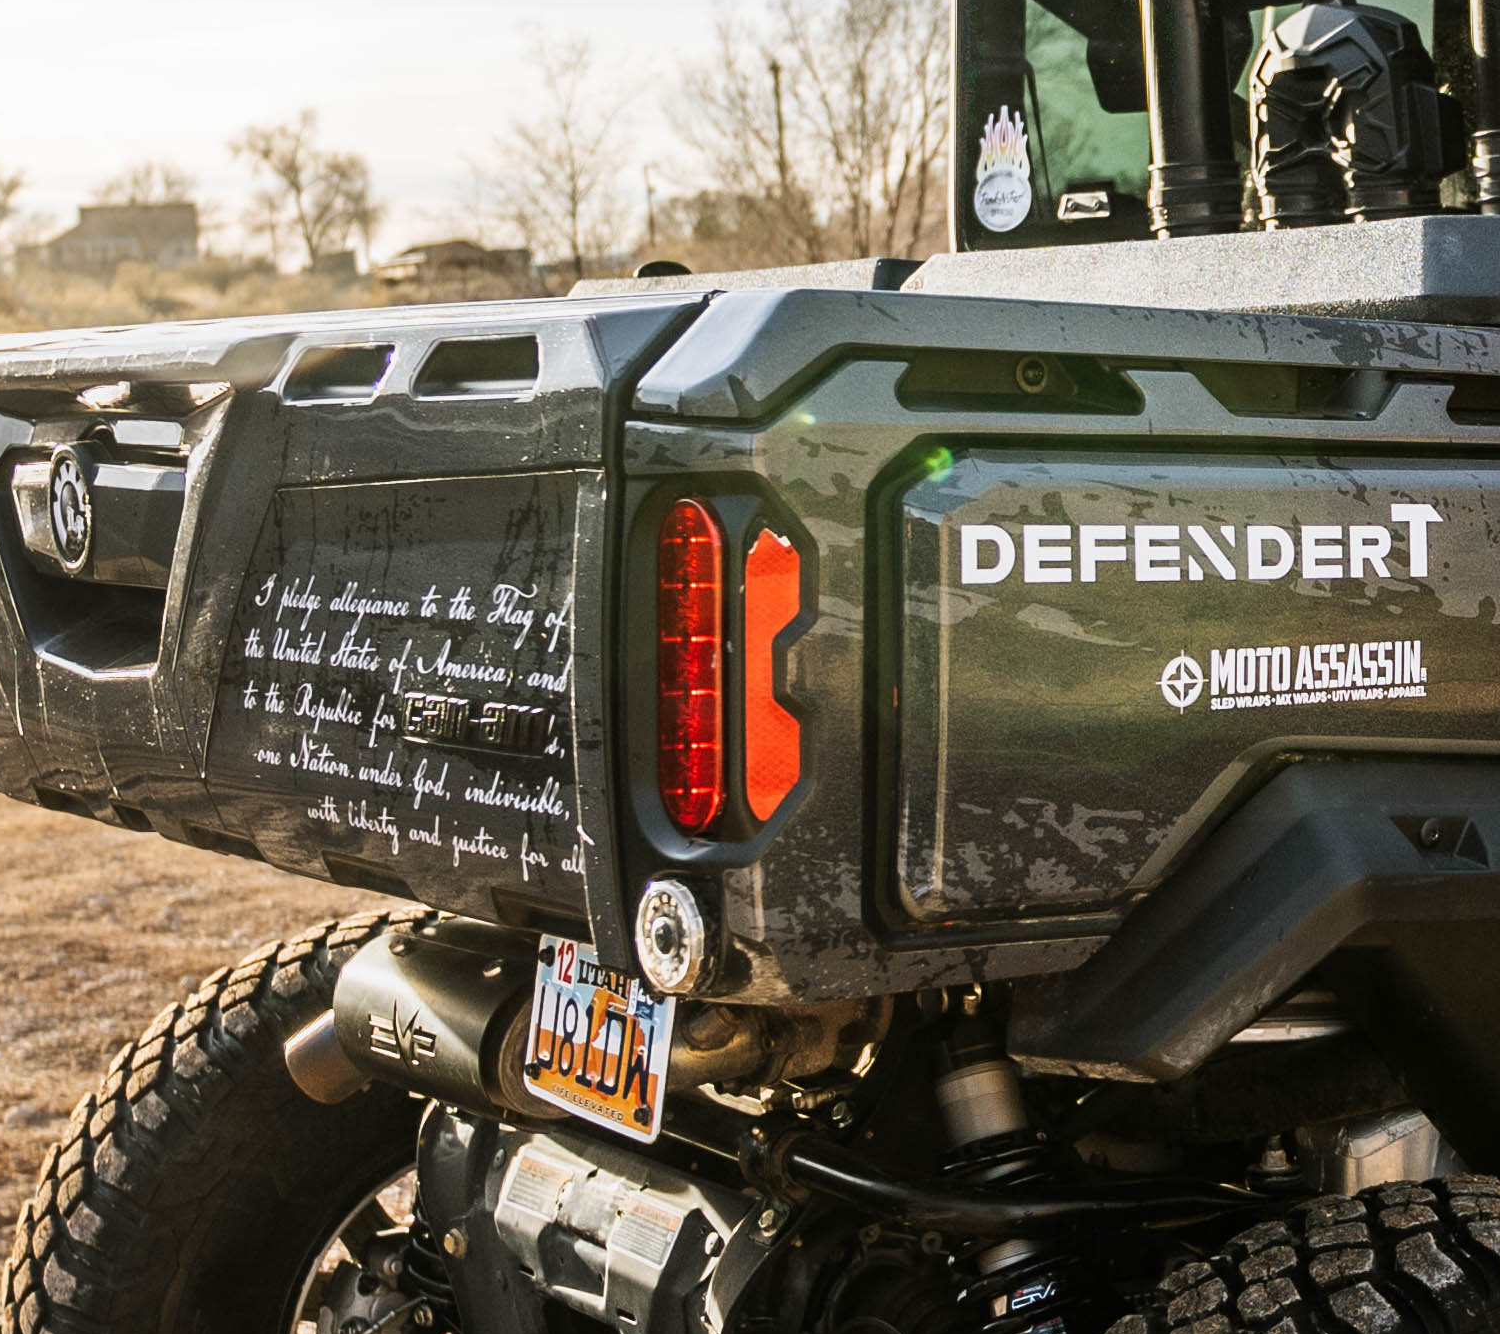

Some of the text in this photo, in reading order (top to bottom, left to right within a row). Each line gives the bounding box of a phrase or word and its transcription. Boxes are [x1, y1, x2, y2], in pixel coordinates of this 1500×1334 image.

[255, 573, 574, 653] I pledge allegiance to the Flag of
[244, 628, 265, 658] the
[272, 627, 326, 665] United
[330, 630, 380, 671] States
[388, 638, 413, 695] of
[527, 653, 574, 692] and
[1211, 640, 1421, 696] MOTO ASSASSIN
[244, 679, 259, 710] to
[264, 682, 285, 714] the
[293, 682, 363, 734] Republic
[368, 693, 397, 748] for
[1211, 697, 1236, 711] SLED
[257, 733, 570, 821] one Nation under God, indivisible,
[307, 795, 340, 824] with
[348, 799, 400, 855] liberty
[409, 815, 442, 847] and
[451, 821, 510, 868] justice
[520, 832, 549, 882] for
[557, 939, 575, 985] 12
[577, 959, 631, 1000] UTAH
[535, 984, 655, 1107] U81DW
[552, 1084, 625, 1123] LIFE ELEVATED
